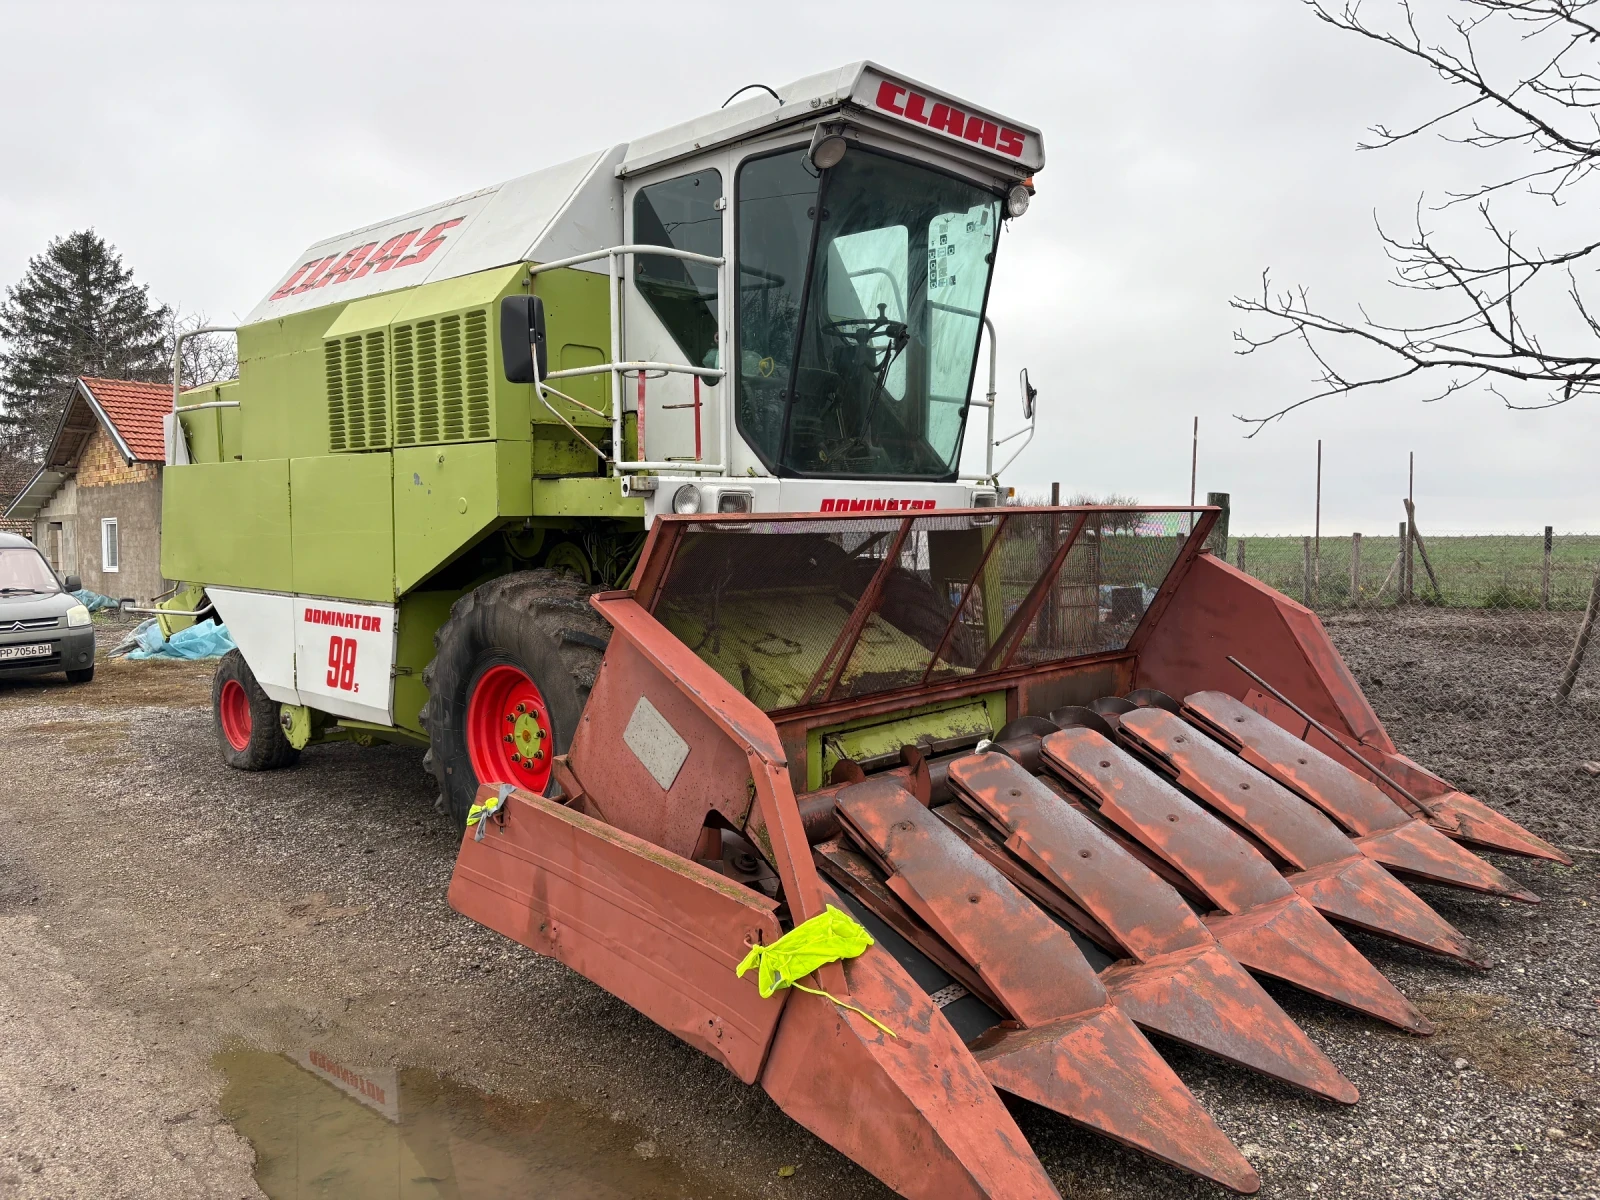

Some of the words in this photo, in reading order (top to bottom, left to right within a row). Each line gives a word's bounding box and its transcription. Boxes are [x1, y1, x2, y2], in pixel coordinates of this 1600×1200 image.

[876, 80, 1025, 158] CLAAS
[269, 215, 468, 301] CLAAS
[304, 608, 381, 632] DOMINATOR
[14, 646, 37, 656] 7056
[38, 645, 51, 654] BH
